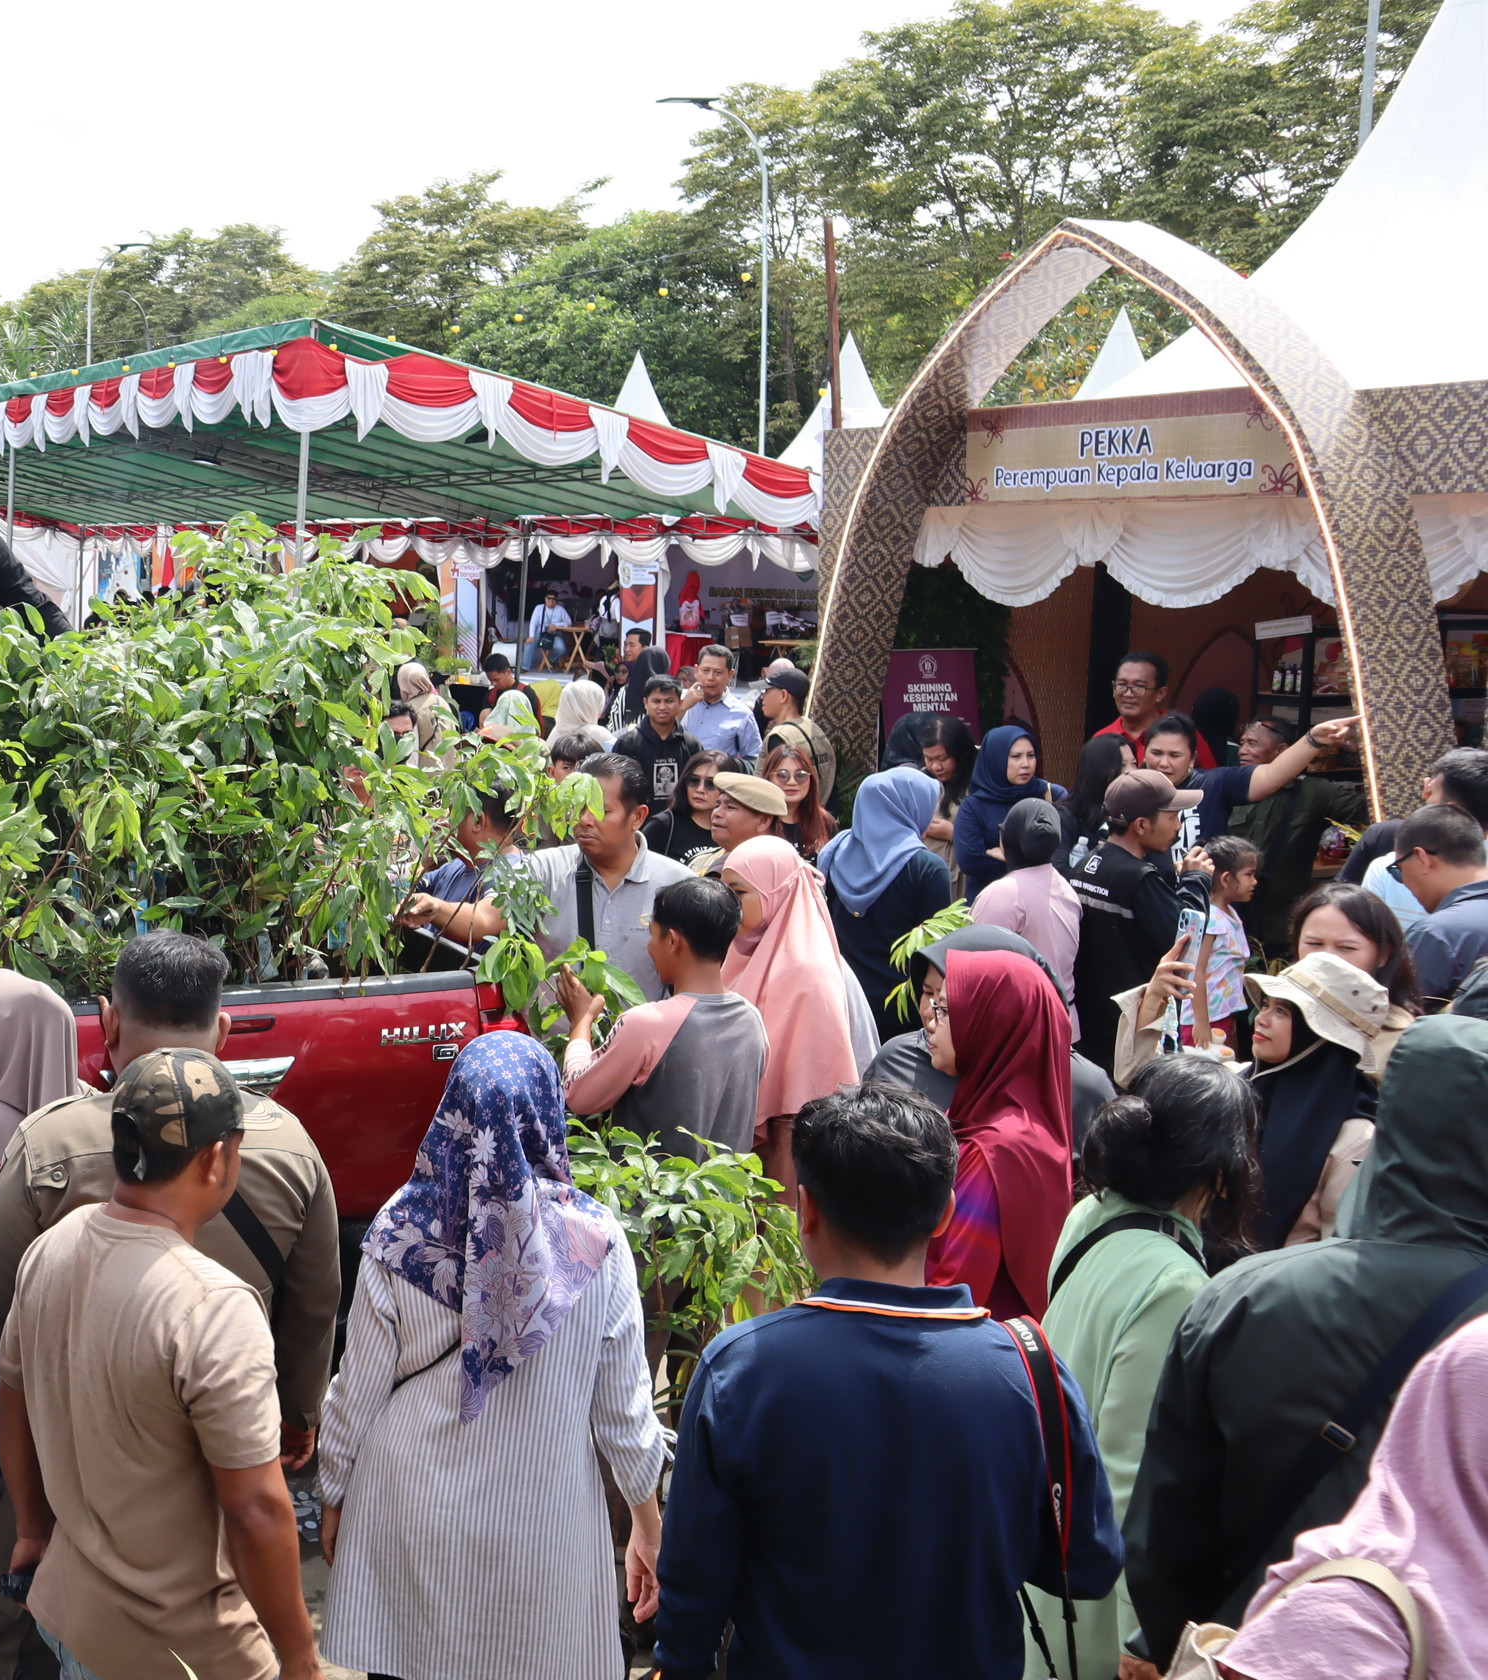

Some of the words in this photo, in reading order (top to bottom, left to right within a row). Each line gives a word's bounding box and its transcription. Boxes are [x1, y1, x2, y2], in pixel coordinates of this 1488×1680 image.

[1079, 427, 1154, 457] PEKKA
[994, 466, 1092, 490] Perempuan
[1096, 459, 1159, 487] Kepala
[1165, 457, 1254, 484] Keluarga
[907, 683, 952, 693] SKRINING
[903, 692, 958, 703] KESEHATAN
[912, 702, 950, 712] MENTAL
[380, 1021, 467, 1046] HILUX
